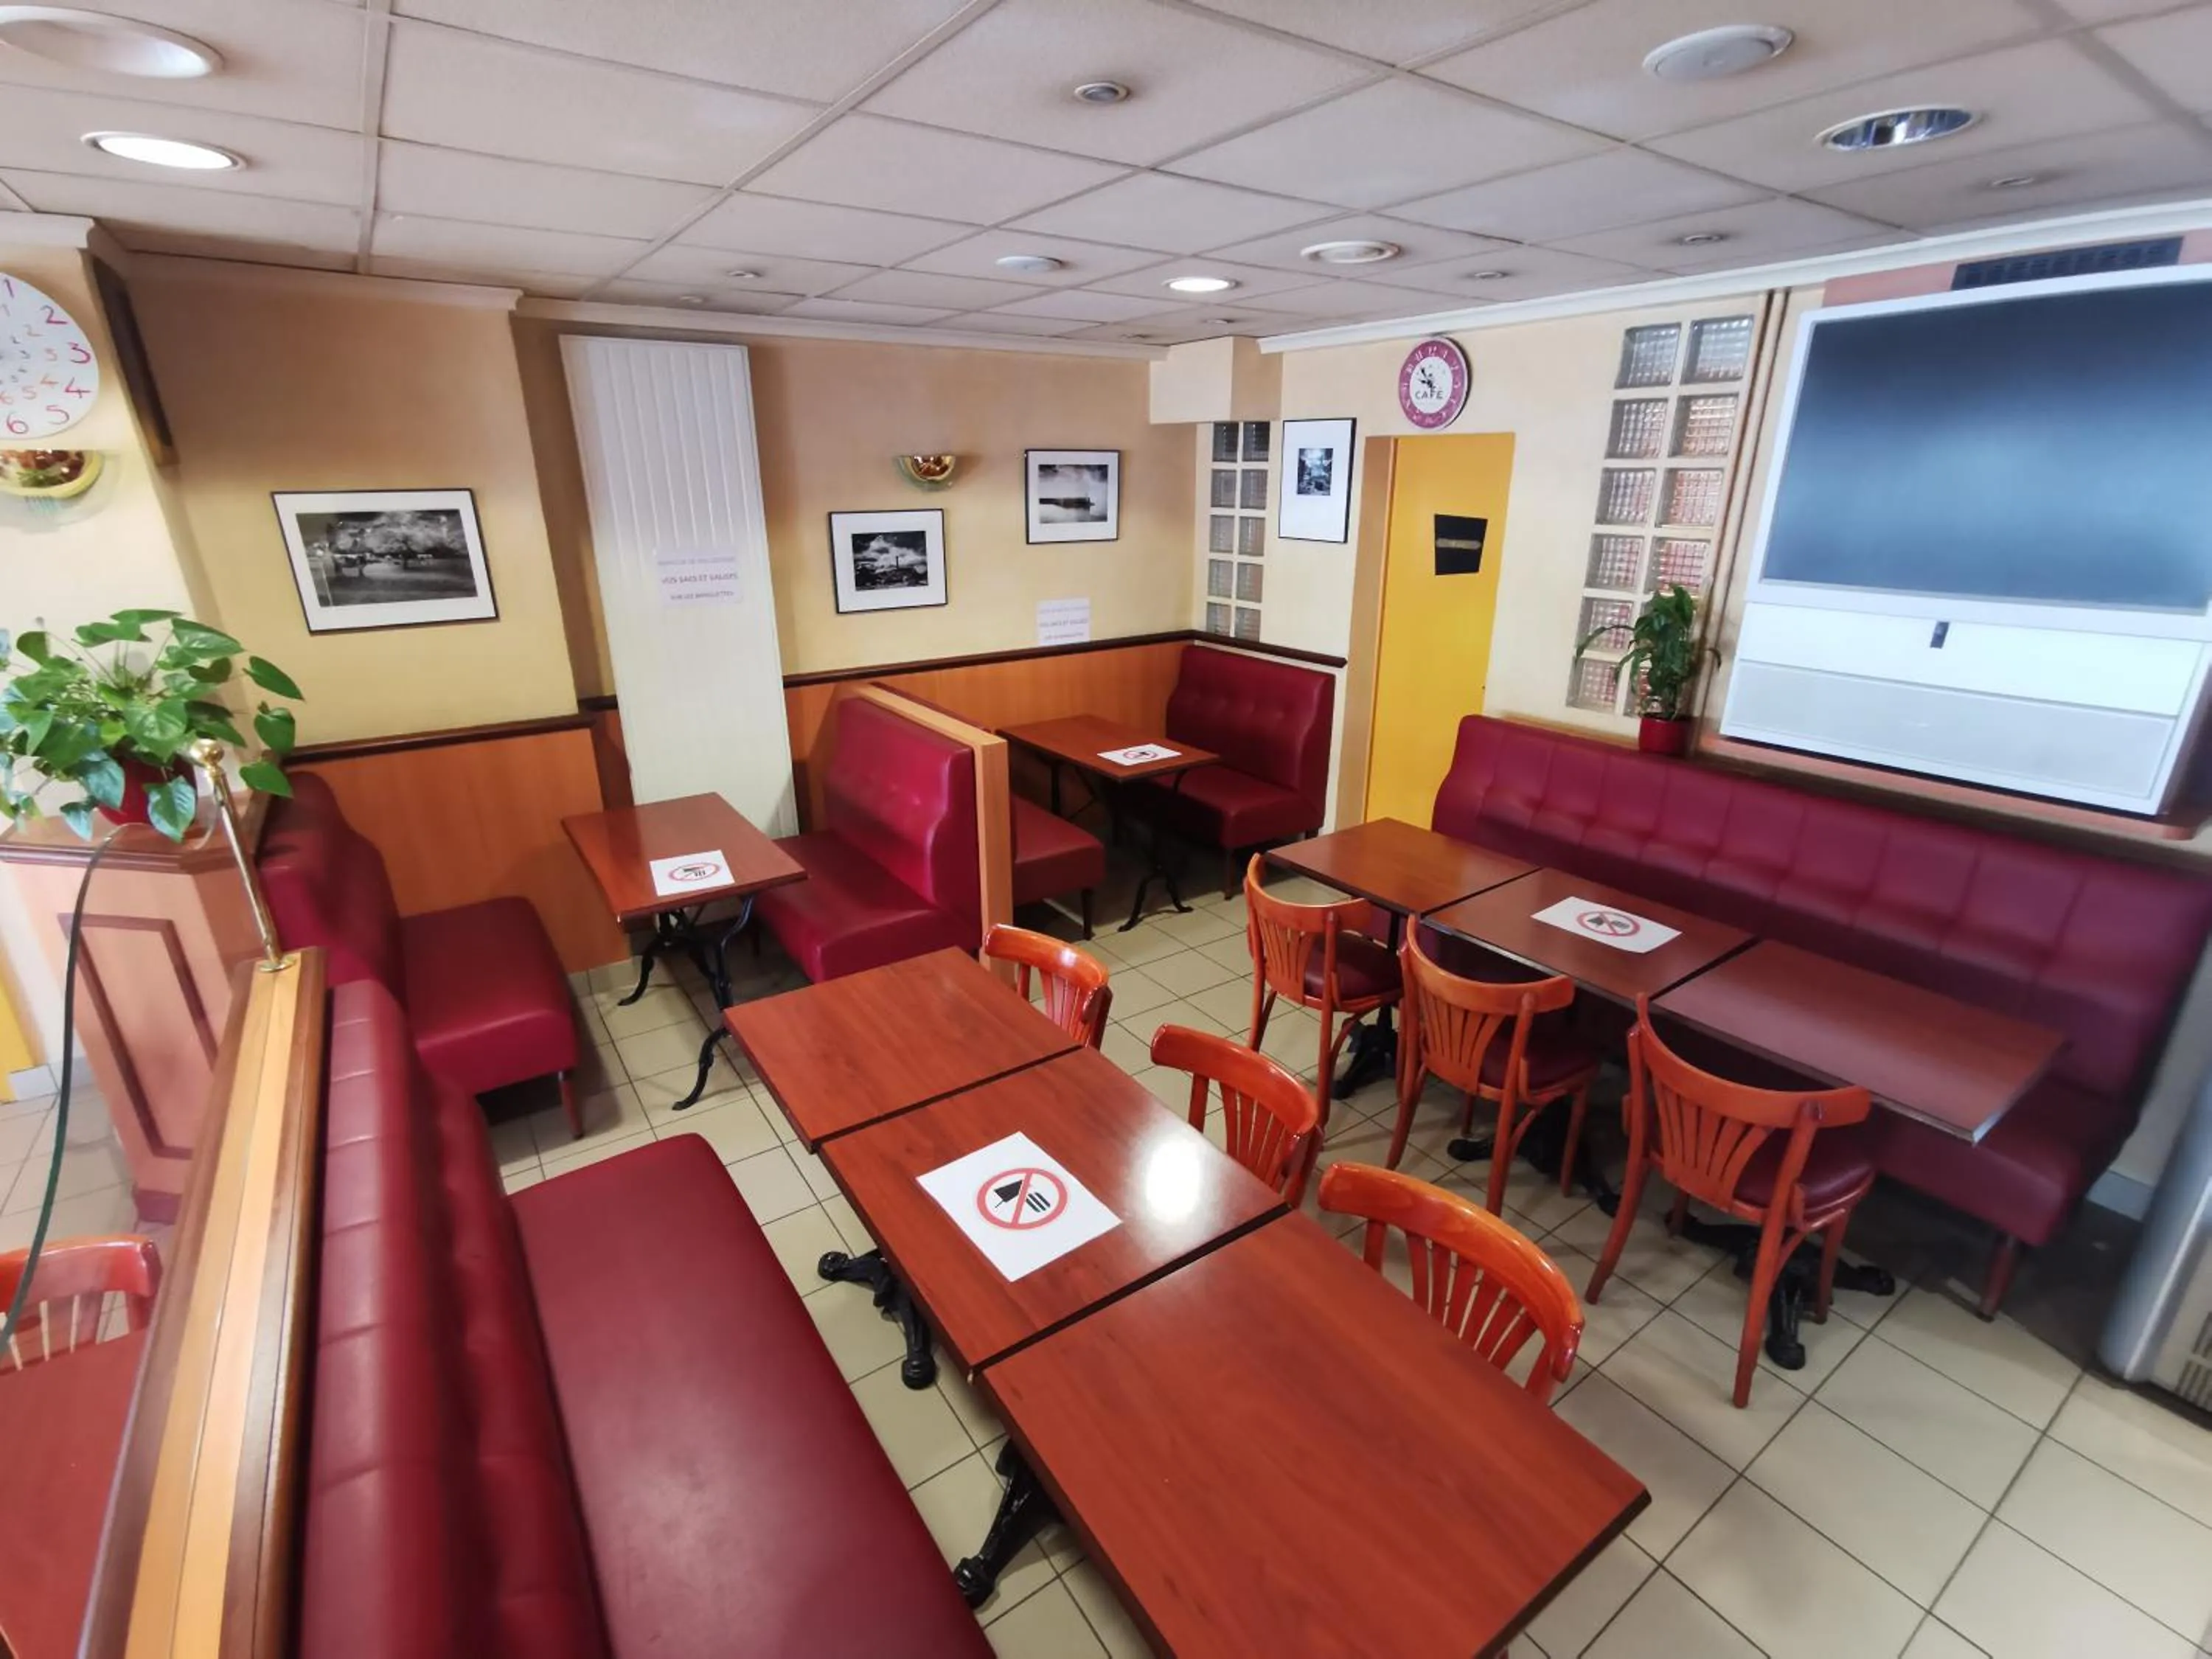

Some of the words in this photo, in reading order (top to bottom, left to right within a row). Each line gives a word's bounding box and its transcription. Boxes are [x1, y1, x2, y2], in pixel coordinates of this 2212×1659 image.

[4, 278, 15, 299] 1
[40, 305, 69, 324] 2
[67, 341, 91, 364] 3
[65, 377, 92, 399] 4
[7, 410, 29, 434] 6
[46, 404, 70, 425] 5
